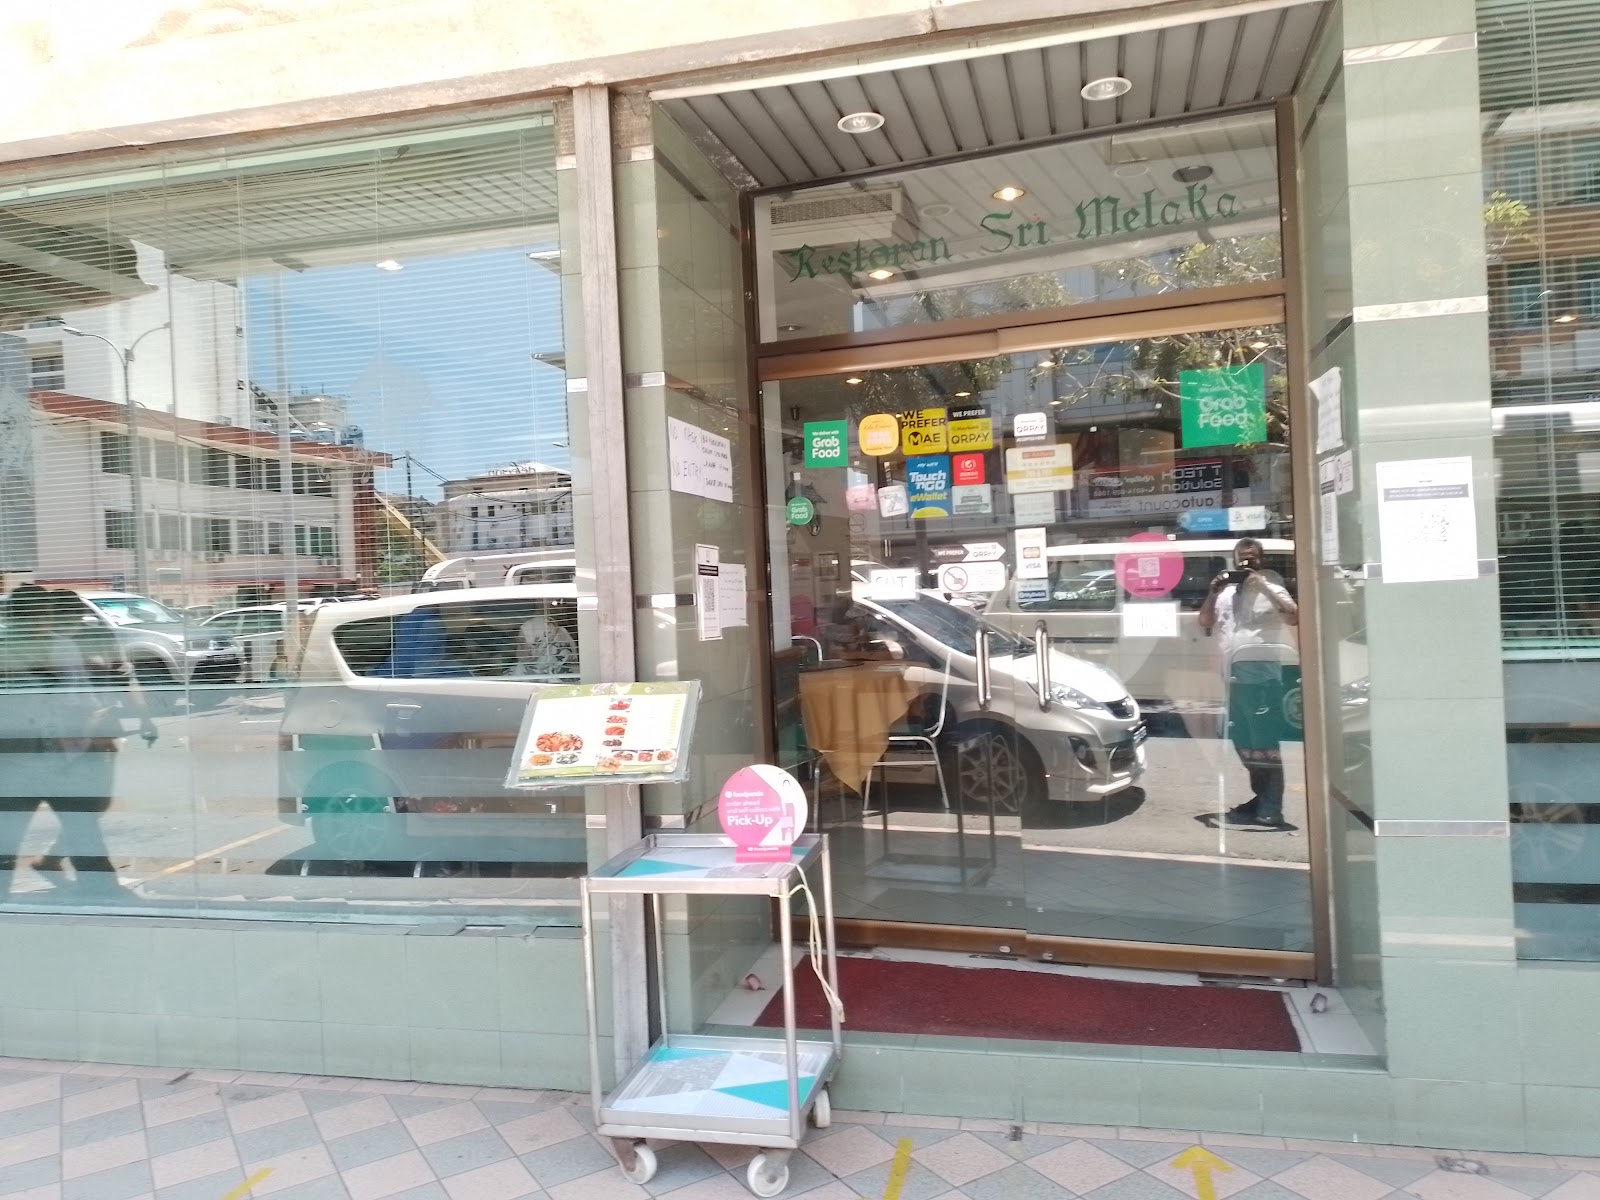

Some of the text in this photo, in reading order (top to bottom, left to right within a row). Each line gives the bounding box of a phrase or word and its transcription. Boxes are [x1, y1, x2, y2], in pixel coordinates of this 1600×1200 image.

[980, 211, 1047, 253] Sri
[903, 410, 923, 420] WE
[963, 408, 987, 417] PREFER
[902, 417, 946, 429] PREFER
[812, 436, 840, 448] Grab
[908, 431, 941, 446] MAE
[951, 433, 989, 445] QRPAY
[812, 446, 841, 459] Food
[909, 469, 947, 482] Touch
[910, 492, 948, 502] eWallet
[727, 814, 774, 827] Pick-Up
